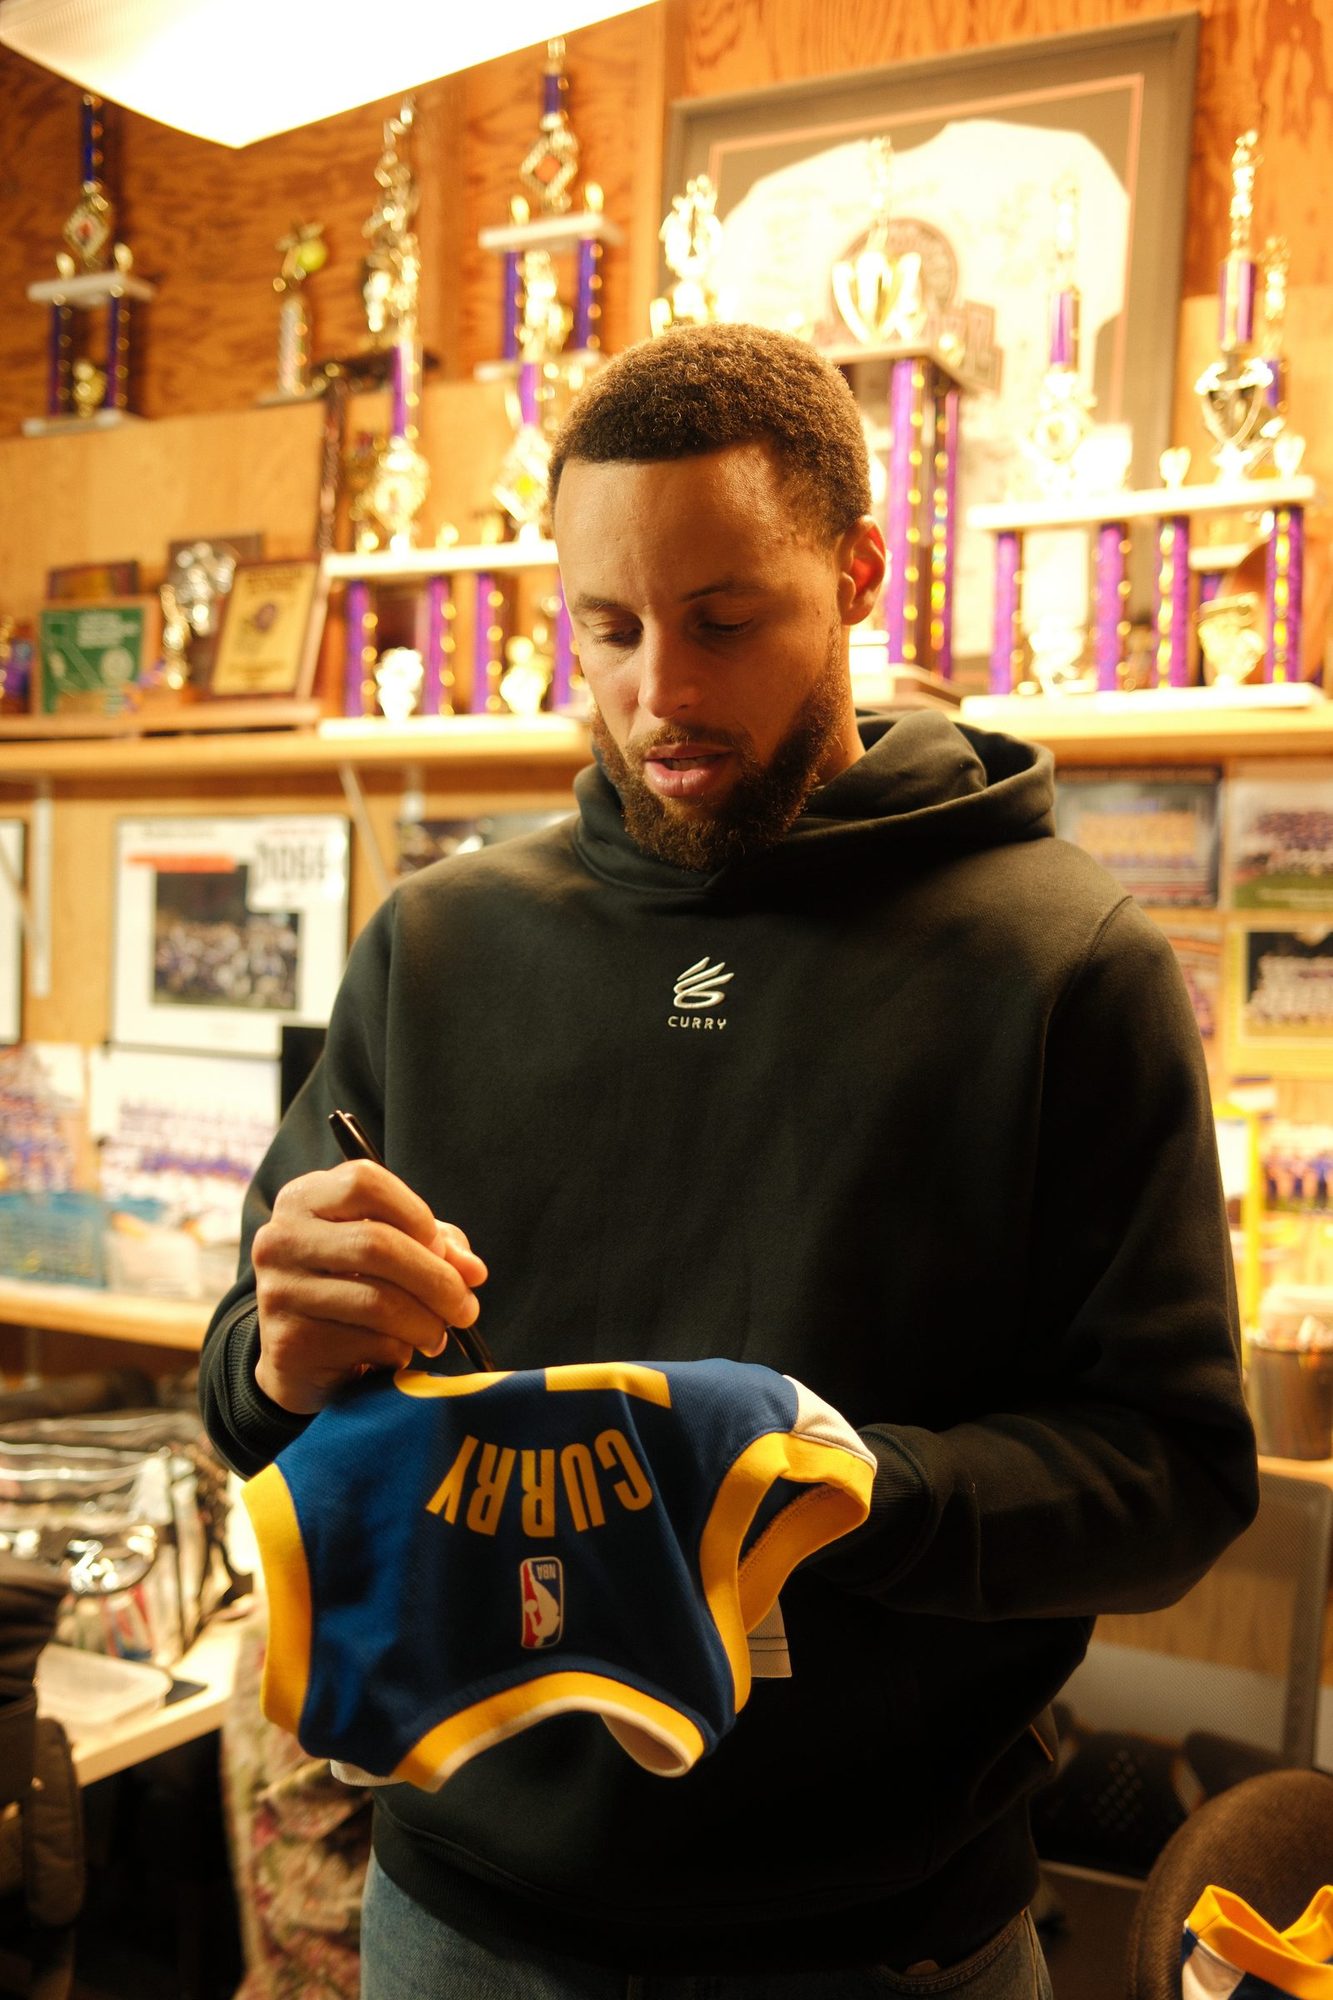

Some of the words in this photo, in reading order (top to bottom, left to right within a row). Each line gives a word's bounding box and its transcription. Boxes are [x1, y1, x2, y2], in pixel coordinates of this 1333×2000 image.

[667, 1015, 727, 1030] CURRY
[425, 1428, 653, 1538] CURRY
[536, 1563, 557, 1580] NBA
